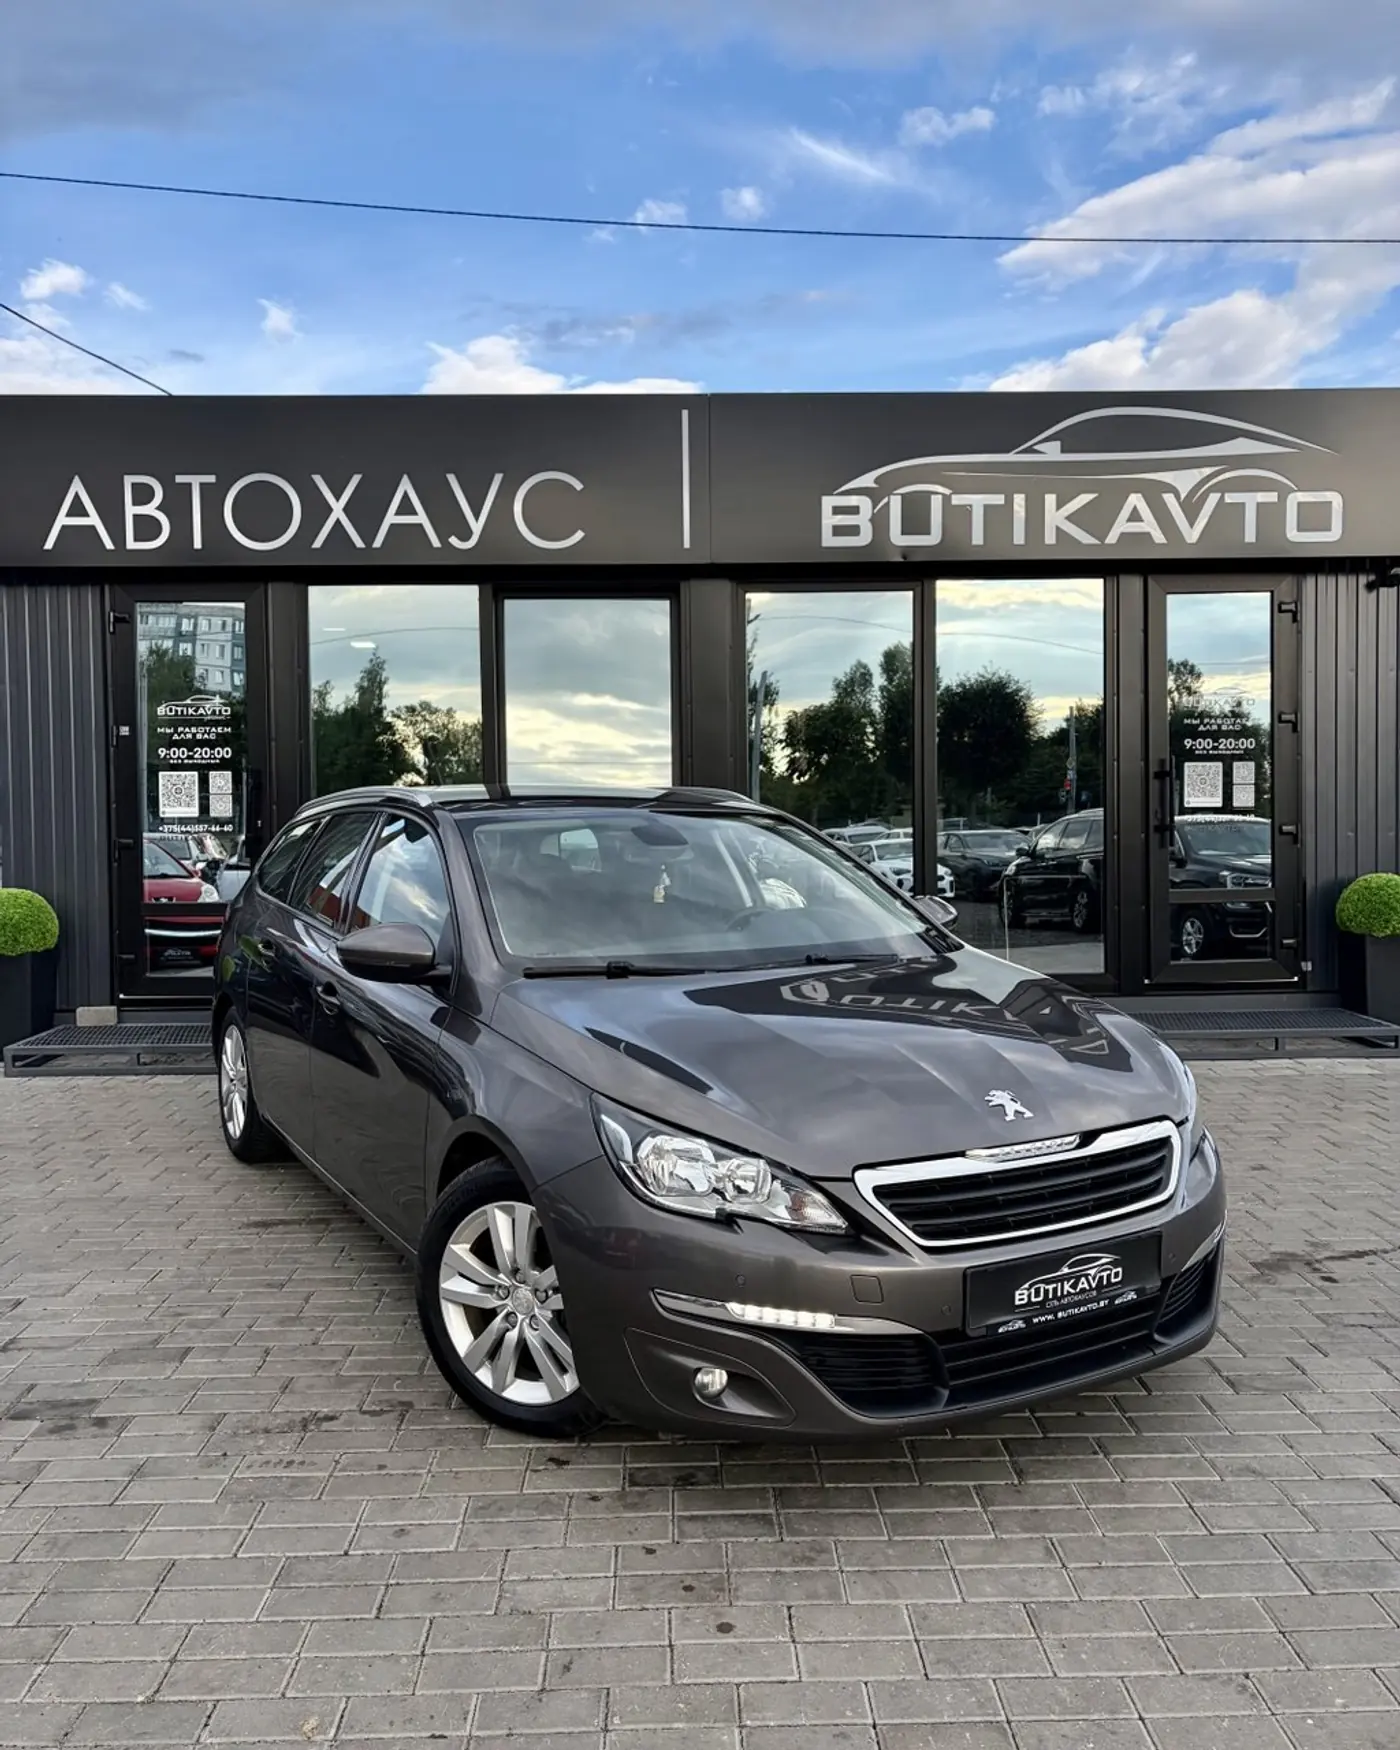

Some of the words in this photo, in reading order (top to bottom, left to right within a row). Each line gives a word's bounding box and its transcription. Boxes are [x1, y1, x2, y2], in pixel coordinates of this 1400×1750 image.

[43, 470, 586, 551] АВТОХАУС
[821, 490, 1343, 547] BUTIKAVTO
[157, 706, 231, 716] BUTIKAVTO
[1203, 717, 1250, 725] РАБОТАЕ
[177, 726, 231, 734] РАБОТАЕМ
[1197, 724, 1218, 732] ДЛЯ
[1184, 738, 1256, 750] 9:00-20:00
[158, 747, 232, 759] 9:00-20:00
[1014, 1267, 1122, 1306] BUTIKAVTO
